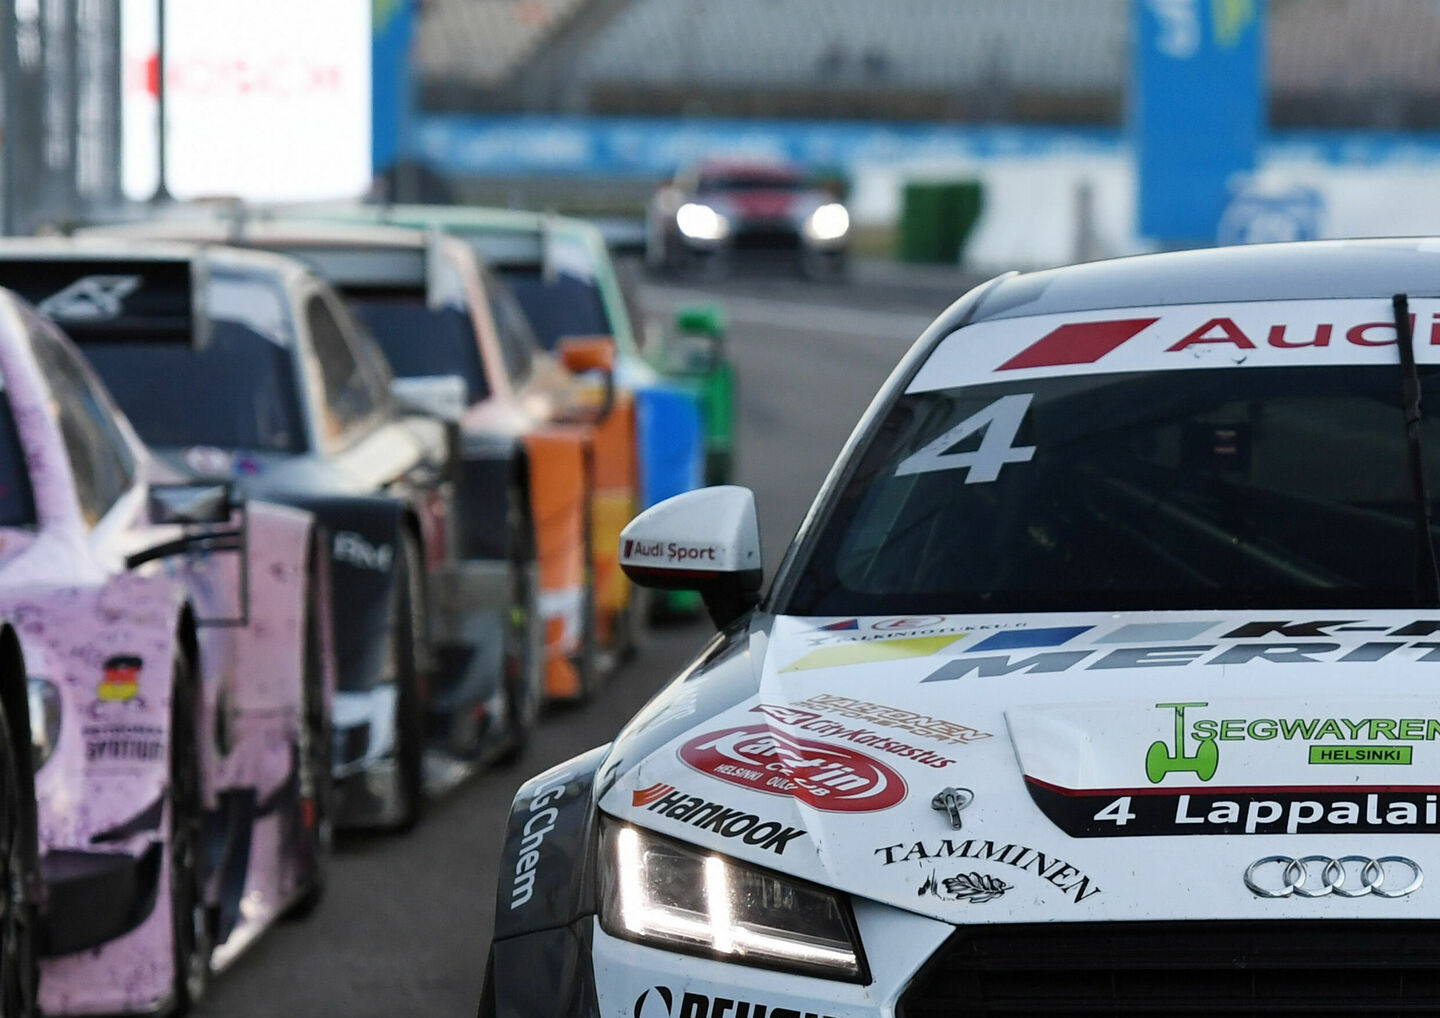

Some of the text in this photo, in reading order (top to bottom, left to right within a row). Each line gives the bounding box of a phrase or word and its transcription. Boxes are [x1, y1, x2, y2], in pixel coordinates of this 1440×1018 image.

[895, 393, 1036, 485] 4
[634, 541, 716, 561] Audi Sport
[804, 693, 994, 743] VALTONEN
[800, 716, 957, 770] CityKatsastus
[1320, 749, 1401, 762] HELSINKI
[713, 764, 764, 780] HELSINKI
[1093, 796, 1137, 825] 4
[874, 837, 1103, 904] TAMMINEN
